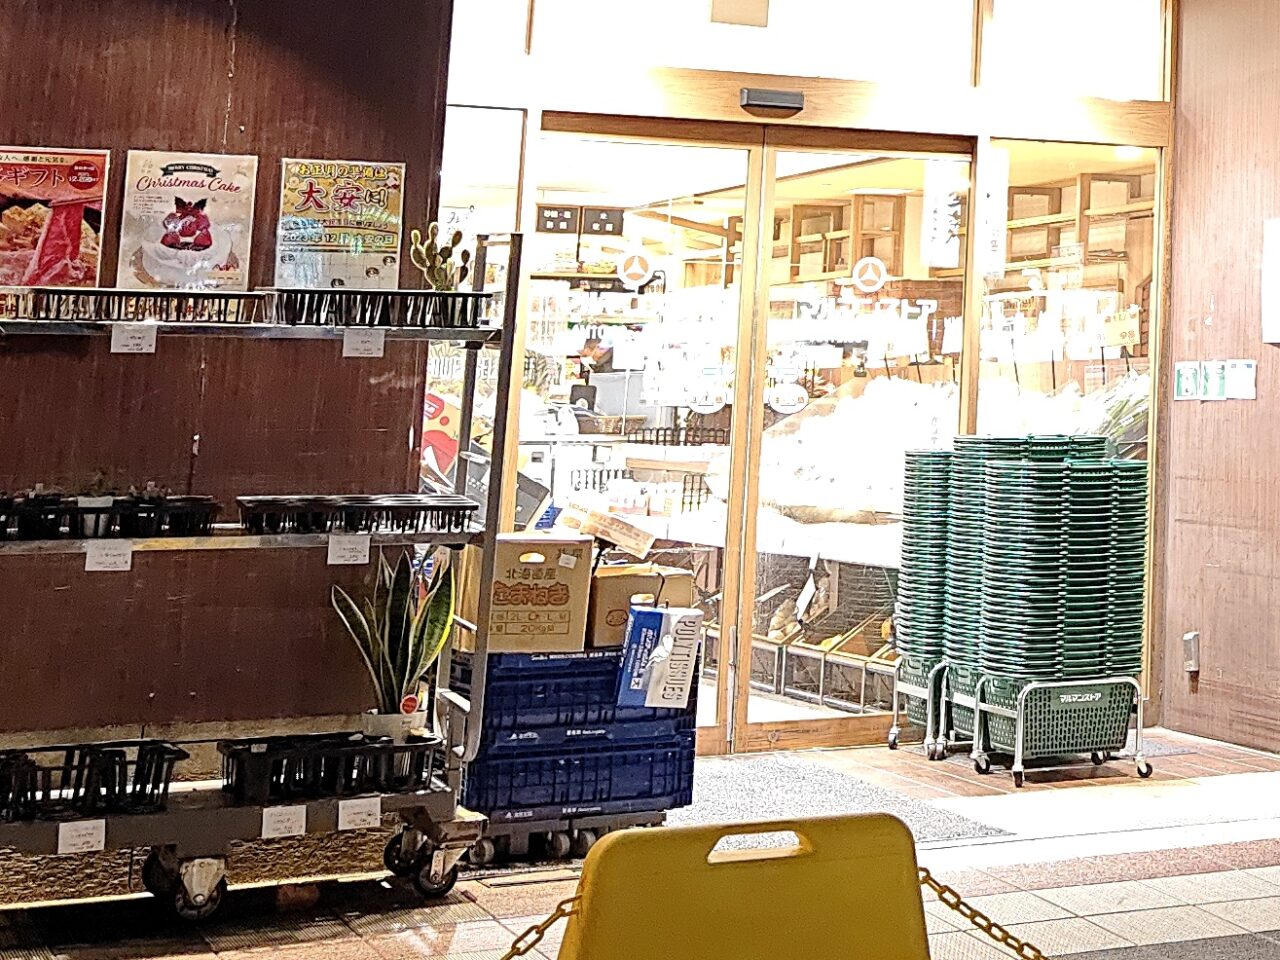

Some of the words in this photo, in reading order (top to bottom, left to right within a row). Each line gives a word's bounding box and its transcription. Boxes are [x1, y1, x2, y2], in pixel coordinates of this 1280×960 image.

[136, 175, 206, 192] Christmas
[207, 177, 241, 193] Cake
[505, 568, 558, 580] 北海道産
[1059, 692, 1102, 704] マルマンストア
